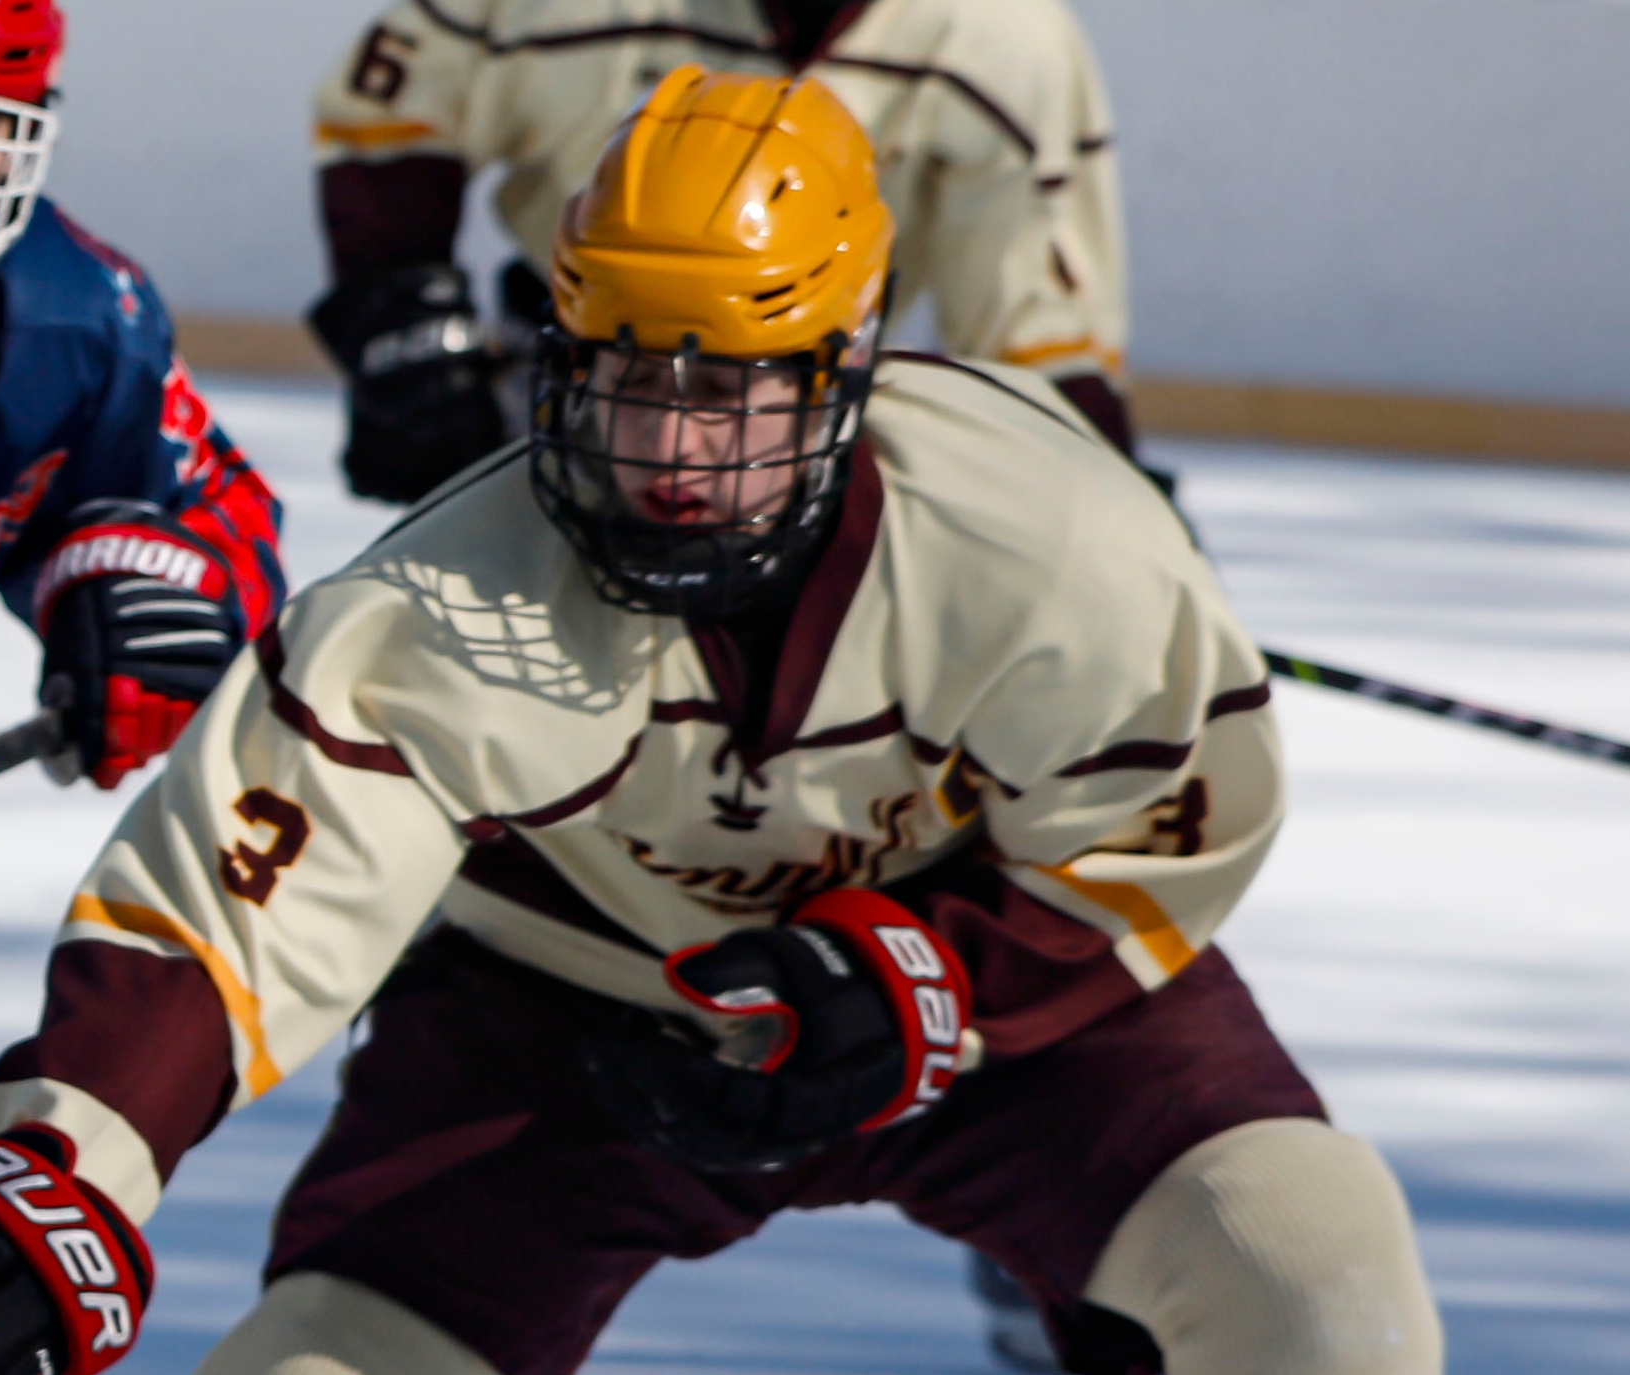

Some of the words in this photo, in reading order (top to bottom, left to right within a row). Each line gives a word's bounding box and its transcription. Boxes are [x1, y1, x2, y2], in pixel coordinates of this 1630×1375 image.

[352, 27, 414, 104] 6
[218, 786, 313, 908] 3
[872, 924, 960, 1108] BAU
